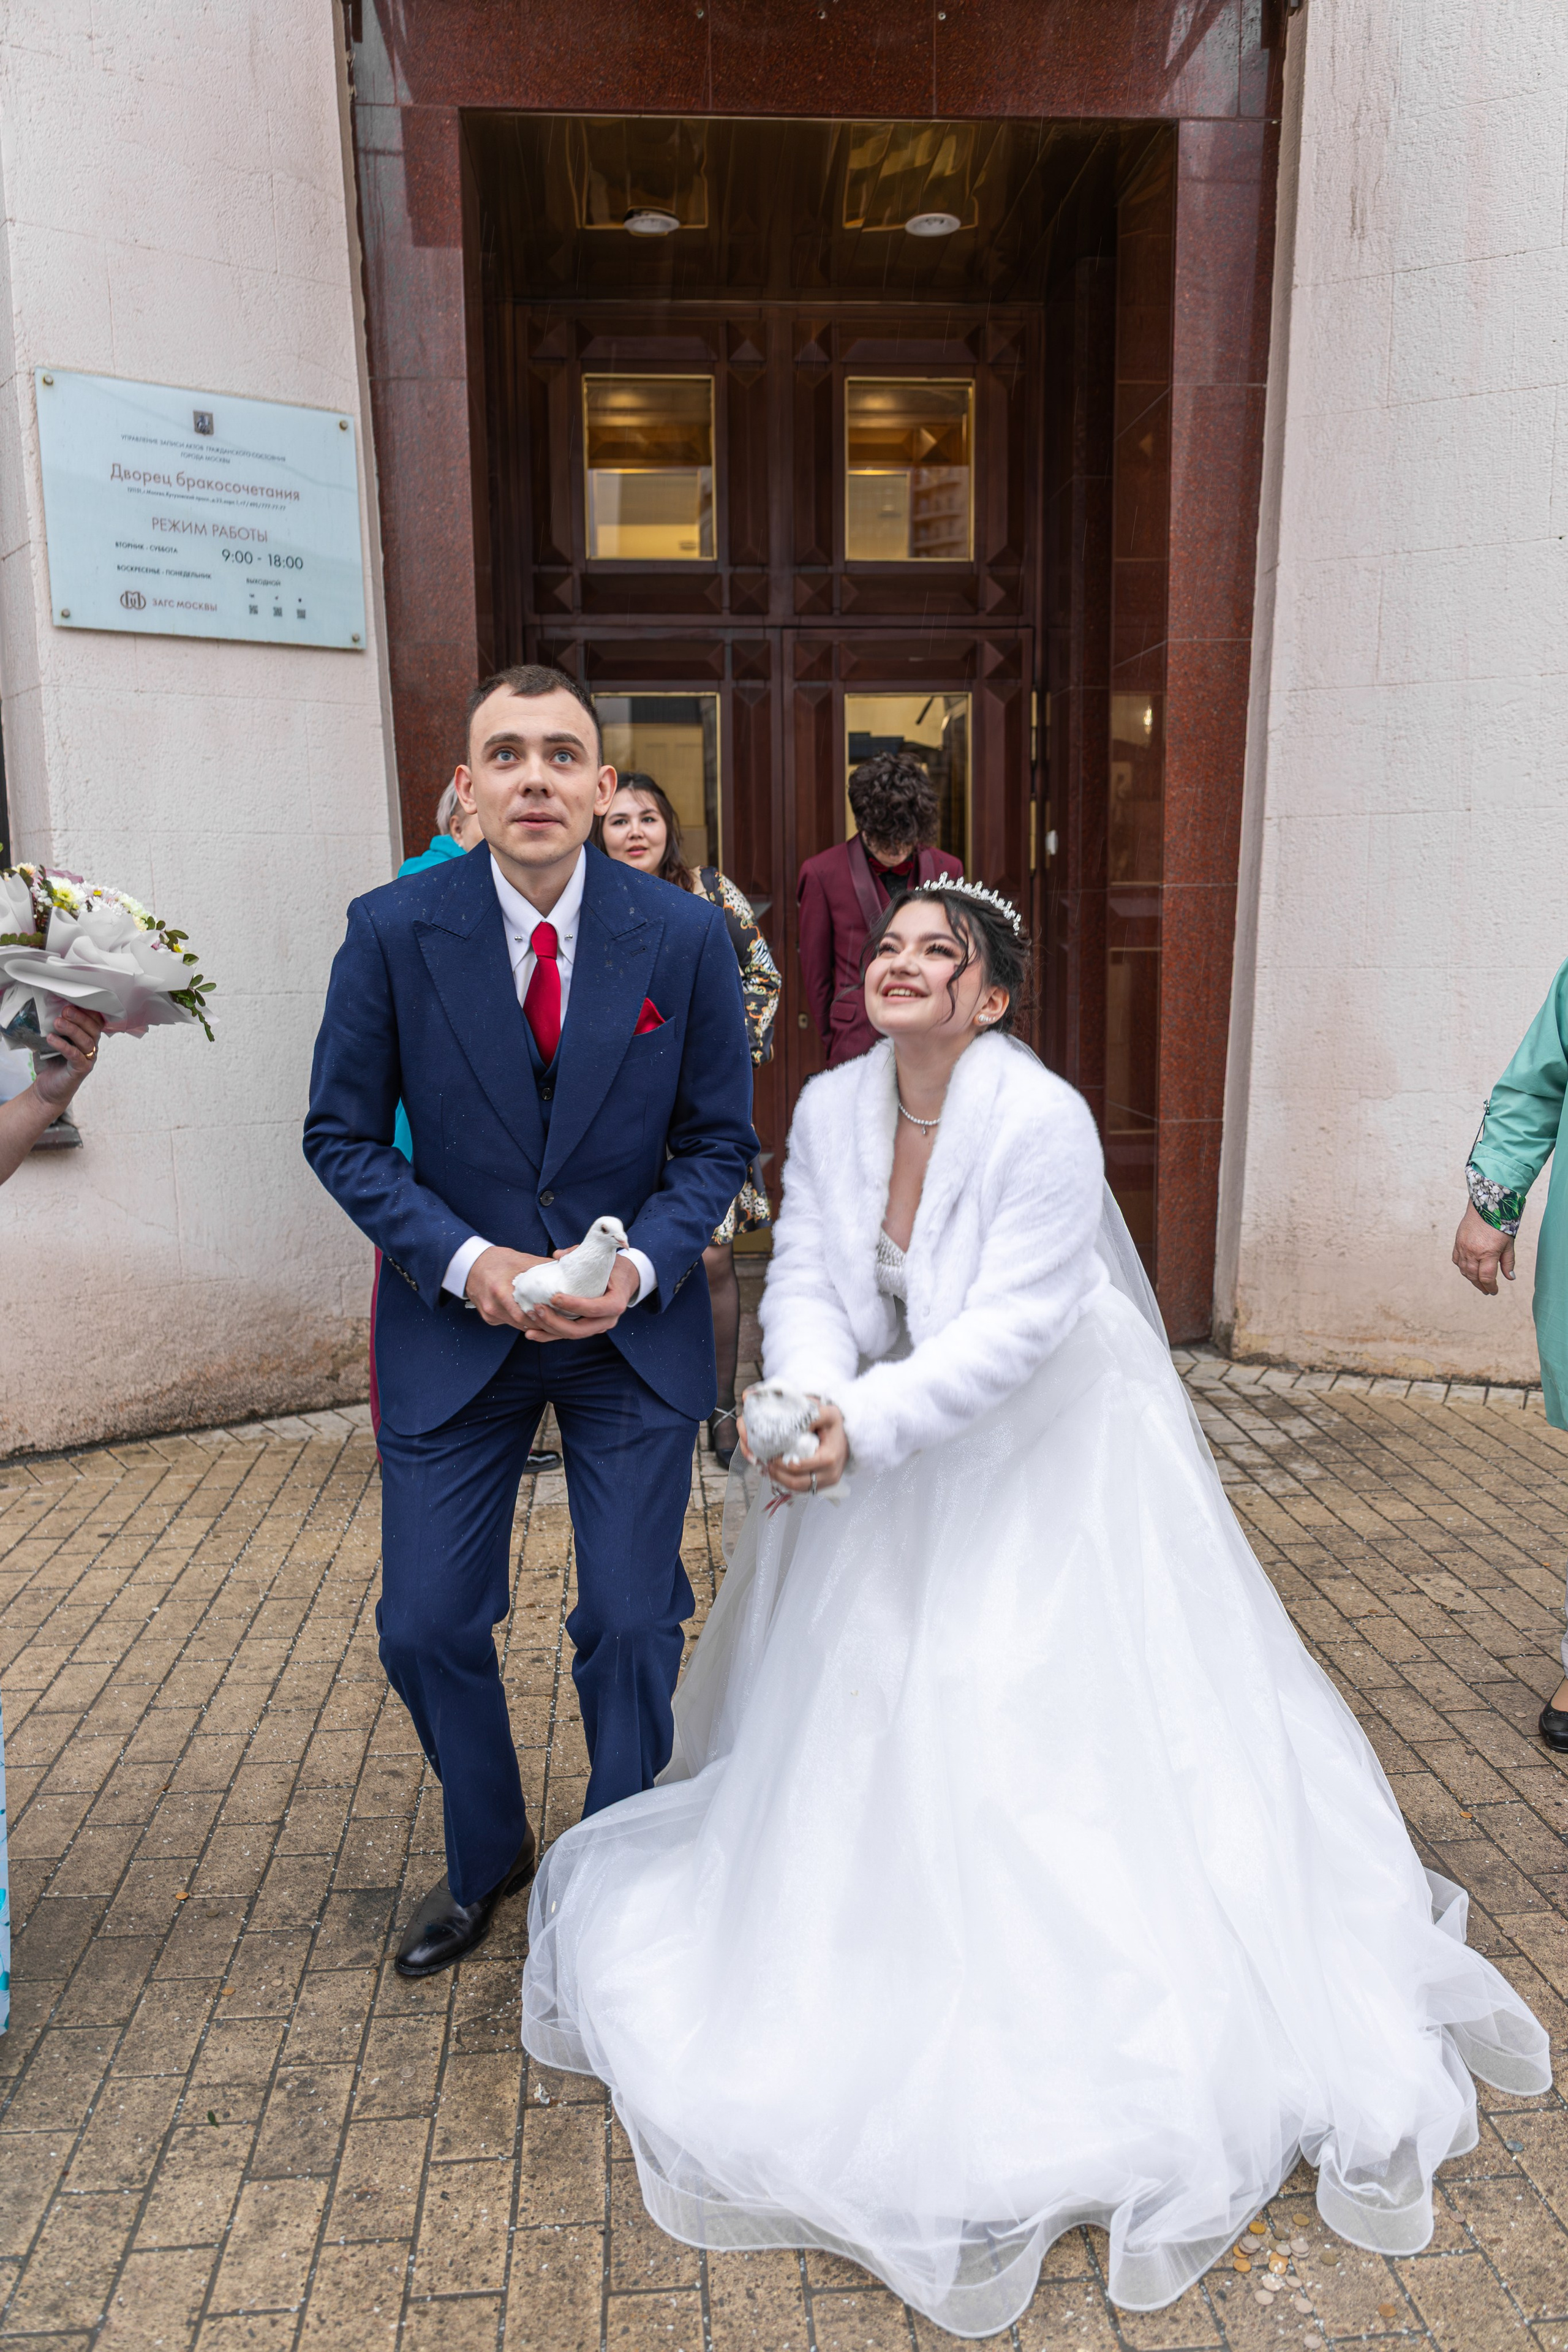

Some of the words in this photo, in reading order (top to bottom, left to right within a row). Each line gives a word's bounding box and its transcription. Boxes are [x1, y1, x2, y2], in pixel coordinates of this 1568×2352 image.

[110, 462, 172, 488] Дворец
[176, 471, 300, 503] бракосочетания
[151, 517, 208, 536] РЕЖИМ
[212, 524, 268, 543] РАБОТЫ
[115, 541, 145, 551] ВТОРНИК
[149, 545, 178, 554] СУББОТА
[222, 549, 253, 565] 9:00
[268, 554, 304, 570] 18:00
[117, 564, 160, 575] ВОСКРЕСЕНЬЕ
[165, 568, 212, 579] ПОНЕДЕЛЬНИК
[246, 577, 281, 587] ВЫХОДНОЙ
[153, 598, 175, 608] ЗАГС
[176, 600, 218, 612] МОСКВЫ
